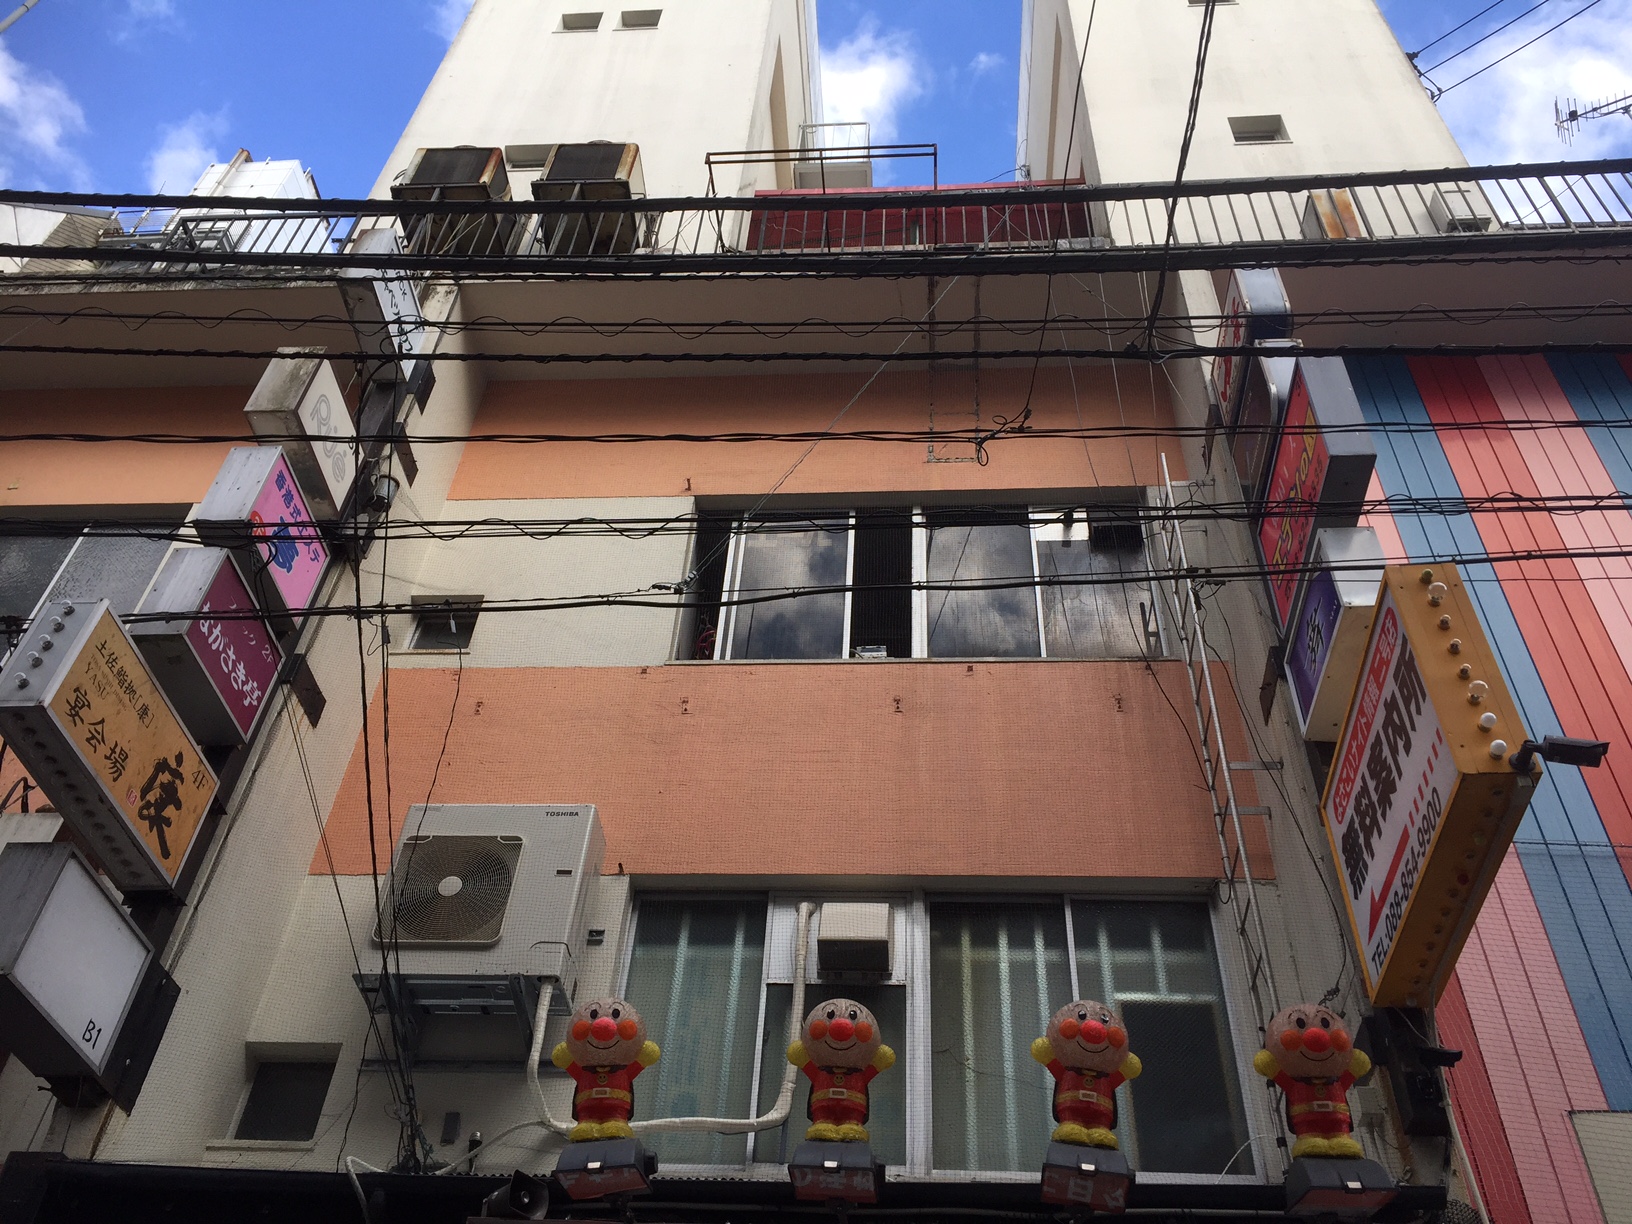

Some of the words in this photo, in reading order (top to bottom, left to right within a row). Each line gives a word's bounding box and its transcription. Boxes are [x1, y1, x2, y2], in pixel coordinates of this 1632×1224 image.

[85, 661, 110, 701] YASU
[199, 600, 262, 707] ながさき亭
[1374, 613, 1397, 683] 二号店
[65, 685, 129, 783] 宴会場
[1342, 632, 1427, 900] 無料案内所
[190, 769, 209, 792] 4F
[82, 1018, 103, 1050] B1
